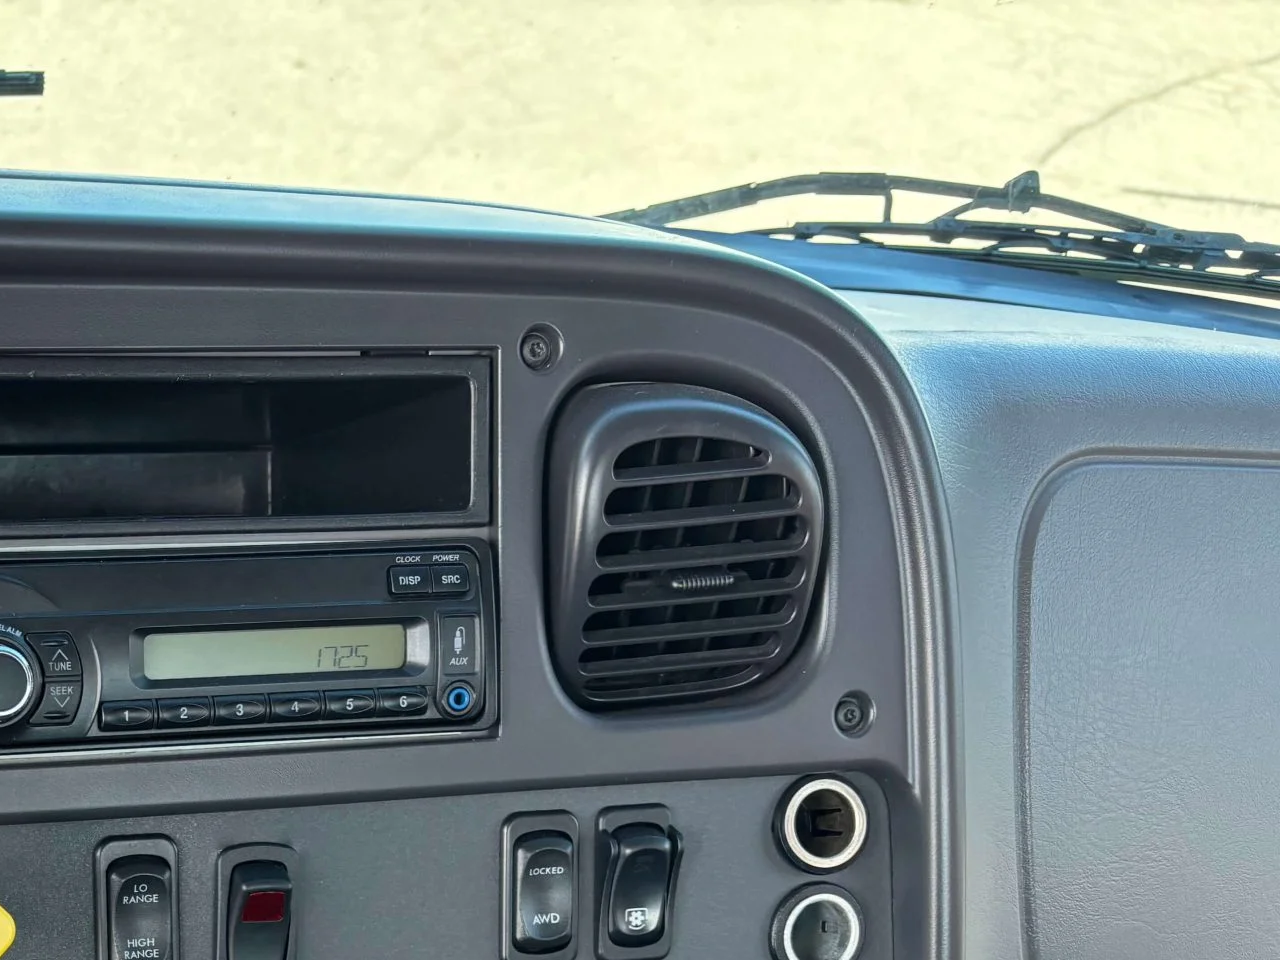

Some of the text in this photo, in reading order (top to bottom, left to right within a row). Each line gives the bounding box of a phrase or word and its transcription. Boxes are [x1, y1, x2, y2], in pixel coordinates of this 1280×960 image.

[395, 554, 460, 563] CLOCK POWER
[399, 575, 461, 585] DISP SRC
[317, 644, 369, 669] 1725
[449, 657, 468, 666] AUX
[48, 660, 73, 672] TUNE
[50, 685, 74, 696] SEEK
[291, 699, 300, 713] 4
[346, 697, 354, 710] 5
[399, 695, 408, 708] 6
[123, 709, 130, 721] 1
[180, 707, 188, 719] 2
[236, 703, 244, 716] 3
[529, 866, 564, 876] LOCKED
[133, 883, 148, 893] LO
[123, 893, 159, 905] RANGE
[532, 912, 560, 925] AWD
[127, 937, 155, 948] HIGH
[124, 948, 160, 960] RANGE
